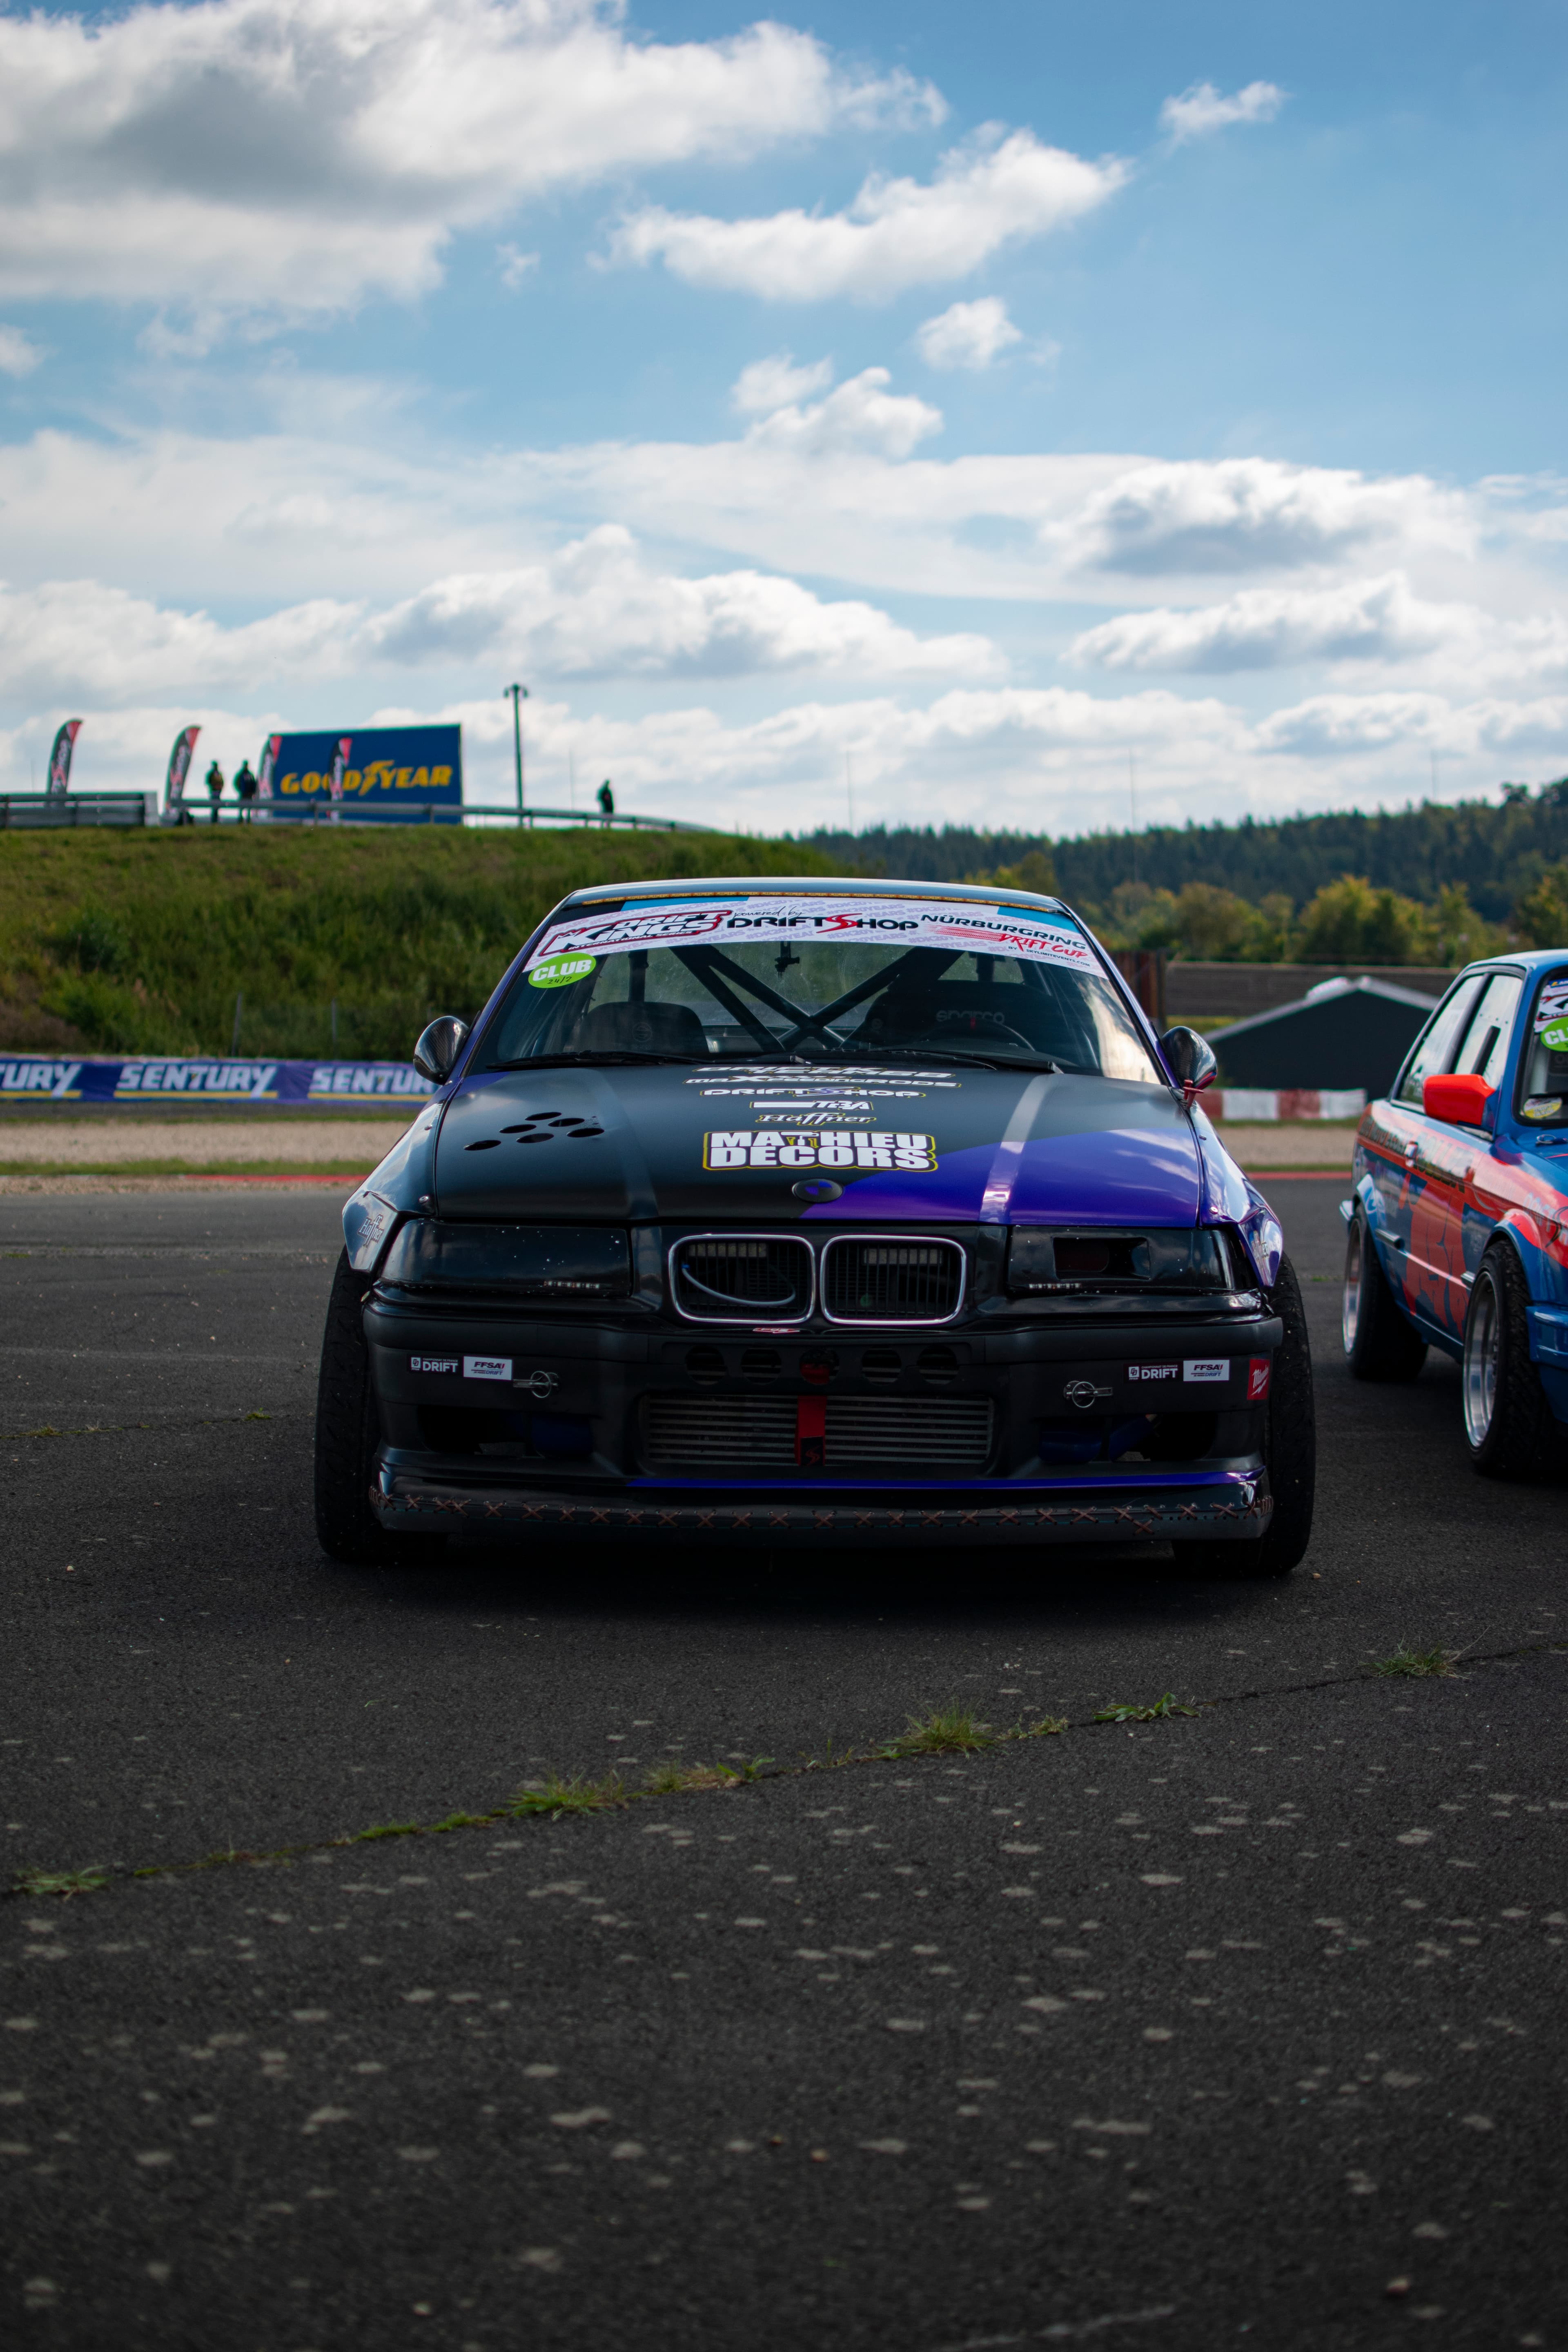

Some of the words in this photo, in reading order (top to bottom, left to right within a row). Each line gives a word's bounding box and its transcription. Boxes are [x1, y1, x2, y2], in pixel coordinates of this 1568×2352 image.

[612, 911, 728, 928] DRIFT
[732, 906, 786, 919] powered
[787, 906, 806, 919] by
[920, 914, 1086, 950] NÜRBURGRING
[569, 934, 653, 949] INTERNATIONAL
[999, 933, 1051, 952] DRIFT
[1051, 944, 1088, 958] CUP
[1026, 949, 1090, 967] SKYLIMITEVENTS.COM
[532, 960, 592, 980] CLUB
[116, 1064, 277, 1098] SENTURY
[760, 1112, 871, 1124] Haffner
[711, 1131, 927, 1150] MATHIEU
[710, 1146, 929, 1168] DECORS
[359, 1214, 383, 1247] Haffner
[423, 1361, 458, 1372] DRIFT
[1141, 1368, 1178, 1379] DRIFT
